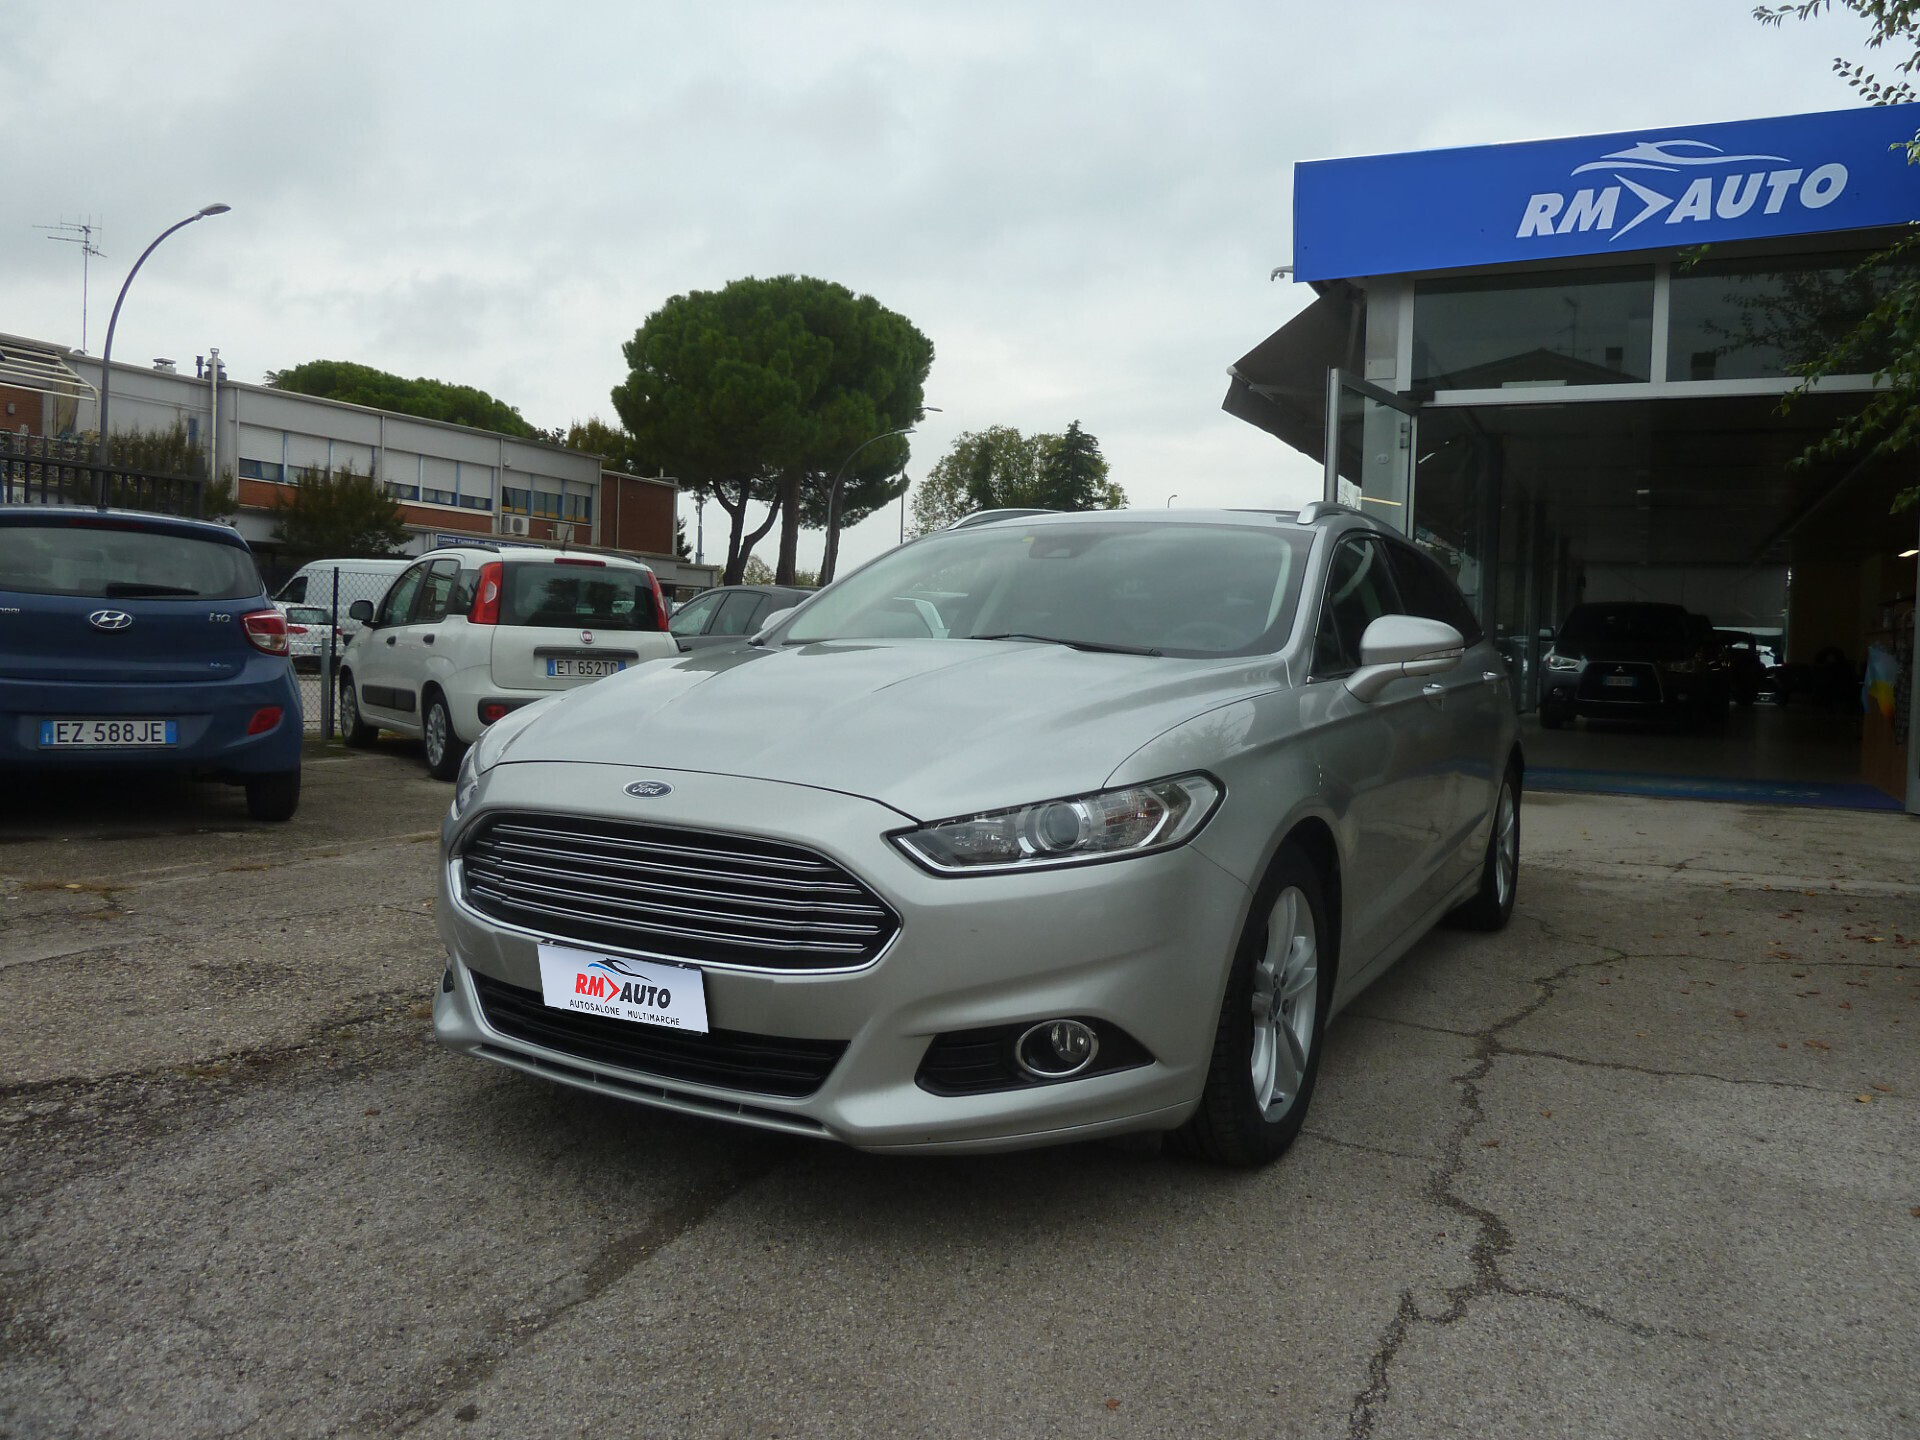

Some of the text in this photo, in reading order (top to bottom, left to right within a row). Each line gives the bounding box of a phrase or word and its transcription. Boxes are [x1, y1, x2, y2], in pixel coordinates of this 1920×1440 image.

[1516, 163, 1848, 238] RM AUTO
[556, 660, 573, 675] ET
[56, 722, 84, 743] EZ
[94, 722, 163, 743] 588JE
[631, 782, 664, 795] Ford
[575, 973, 671, 1009] RM AUTO
[569, 999, 680, 1026] AUTOSALONE MULTIMARCHE
